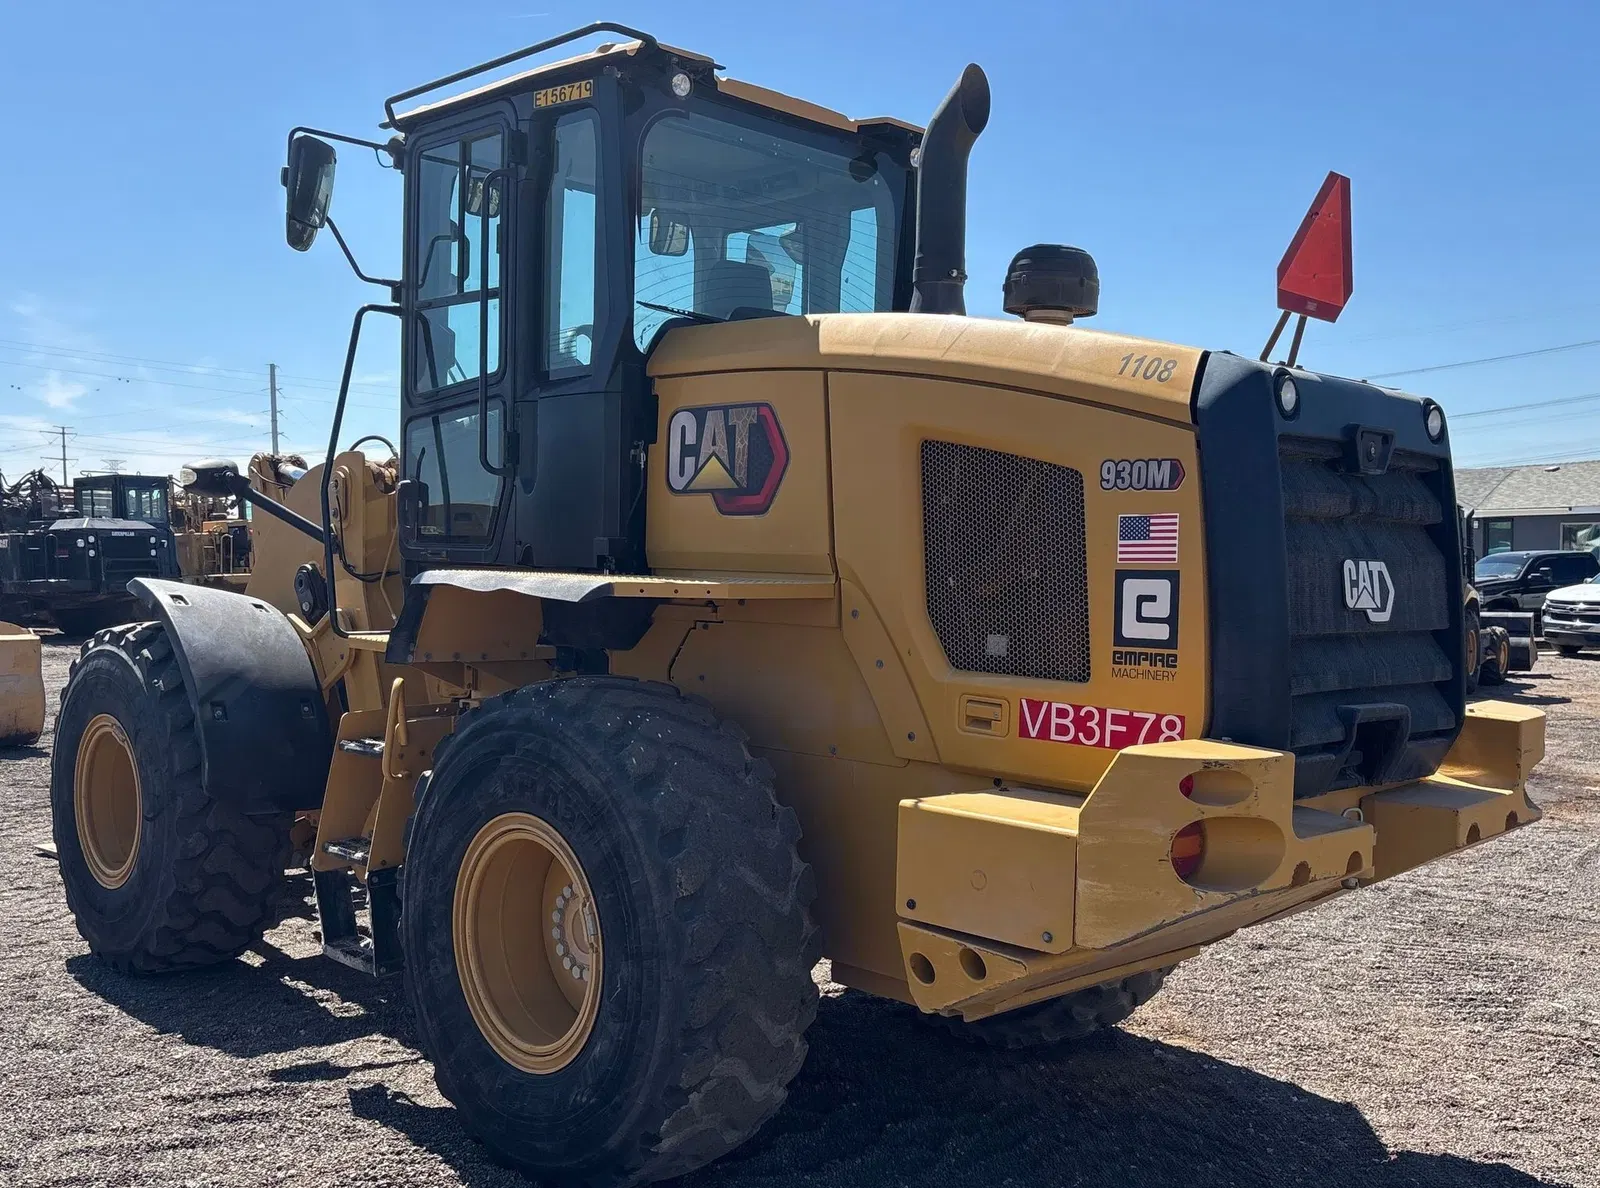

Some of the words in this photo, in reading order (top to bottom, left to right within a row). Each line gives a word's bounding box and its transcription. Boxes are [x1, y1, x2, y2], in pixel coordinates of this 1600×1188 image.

[535, 81, 593, 107] E156719
[1118, 352, 1178, 383] 1108
[669, 407, 758, 491] CAT
[1101, 460, 1171, 489] 930M
[1343, 559, 1382, 609] CAT
[1111, 667, 1177, 681] MACHINERY
[1020, 698, 1182, 748] VB3F78
